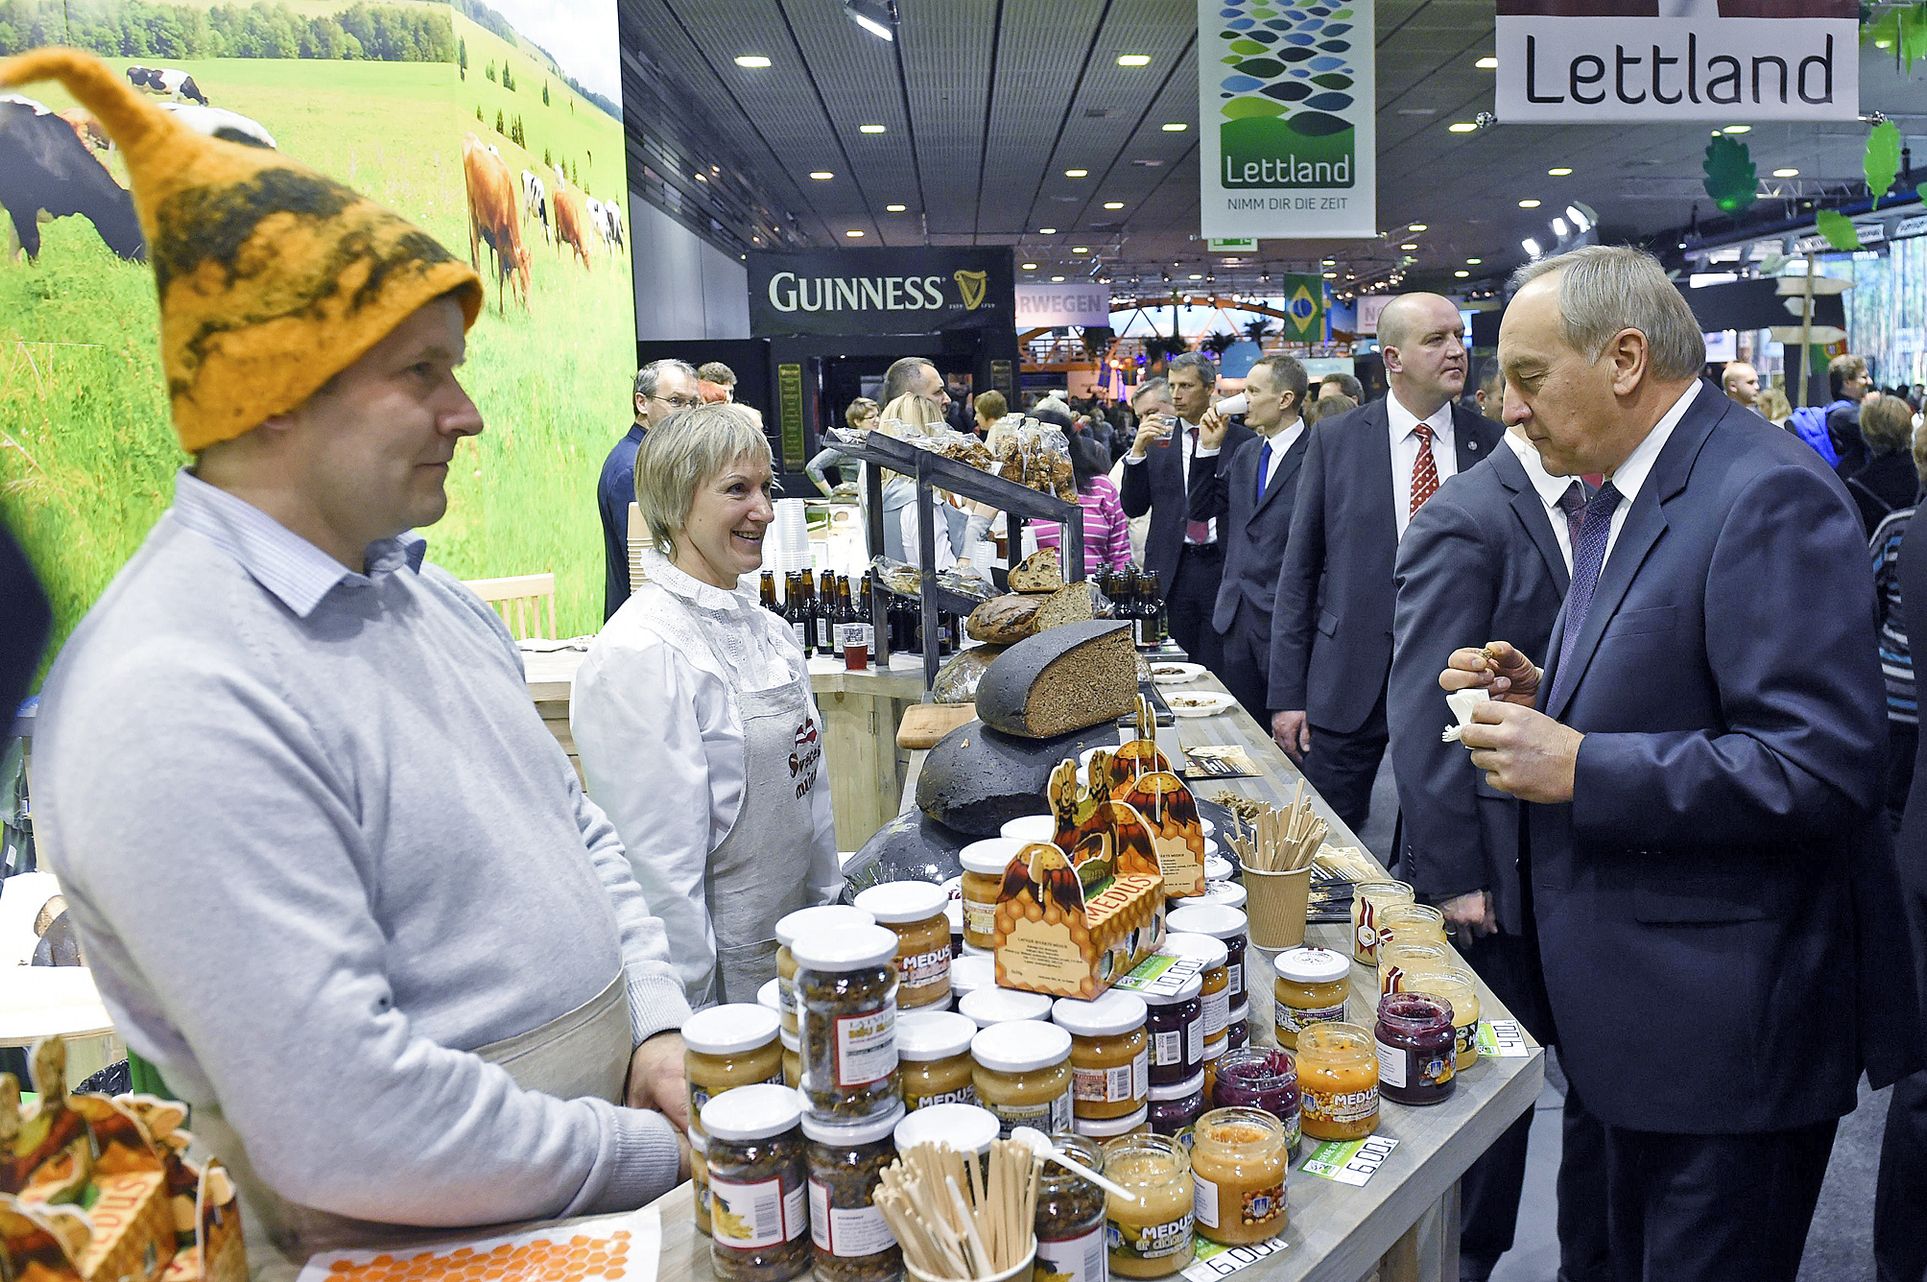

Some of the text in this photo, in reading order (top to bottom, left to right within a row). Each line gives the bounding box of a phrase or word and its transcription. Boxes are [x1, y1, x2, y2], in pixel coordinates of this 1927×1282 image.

[1525, 33, 1833, 105] Lettland
[1226, 153, 1350, 183] Lettland
[1227, 197, 1348, 210] NIMM DIR DIE ZEIT
[768, 271, 944, 312] GUINNESS
[1018, 294, 1102, 313] RWEGEN
[1087, 875, 1152, 921] MEDUS
[902, 944, 951, 970] MEDUS
[1334, 1085, 1379, 1106] MEDUS
[1346, 1142, 1392, 1174] 6.00
[1142, 1212, 1195, 1240] MEDUS
[1206, 1244, 1275, 1276] 6.00
